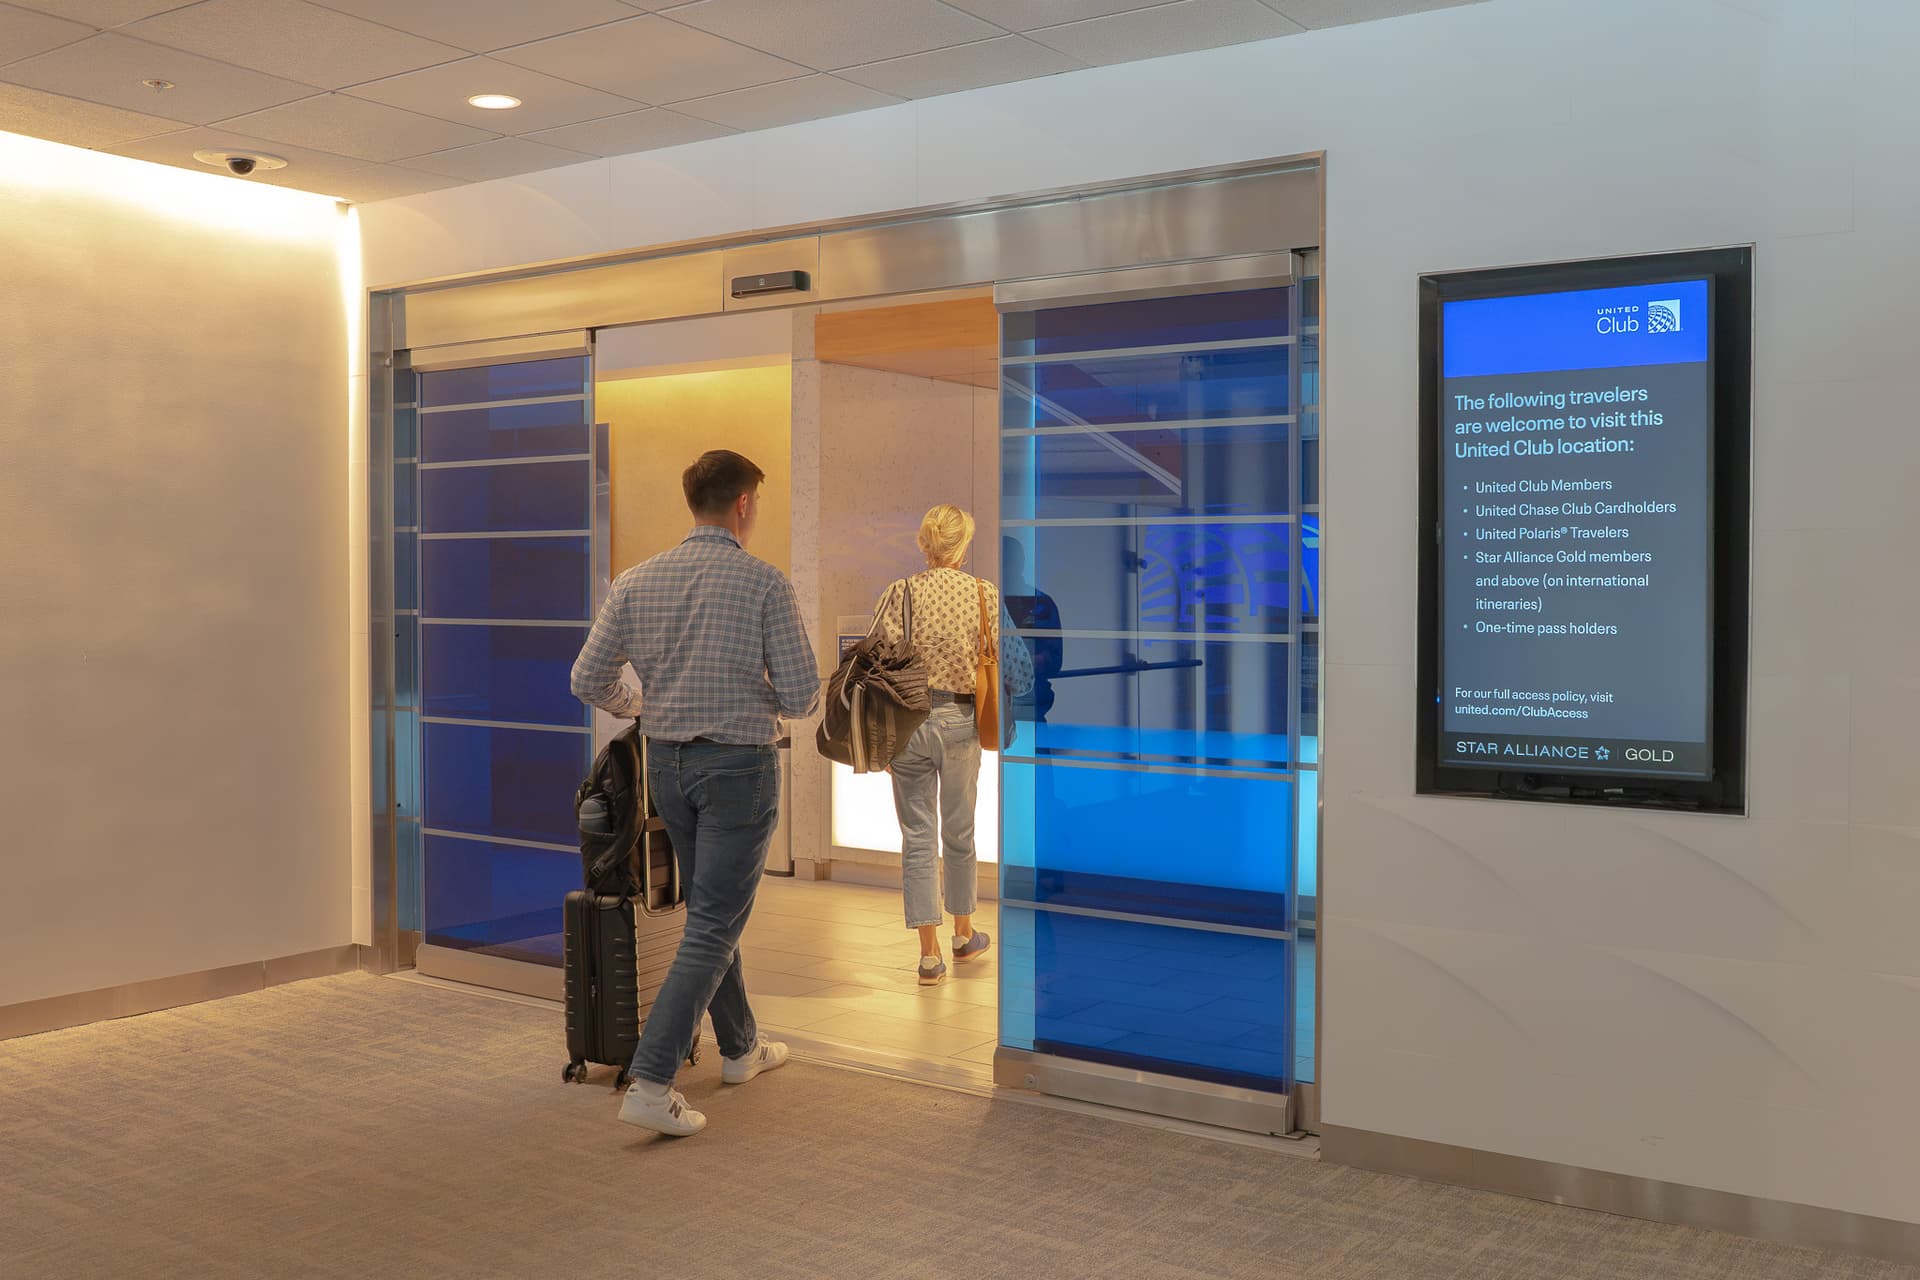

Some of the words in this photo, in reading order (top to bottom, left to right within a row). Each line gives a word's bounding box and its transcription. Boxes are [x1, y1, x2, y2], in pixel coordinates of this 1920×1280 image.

[1597, 306, 1639, 315] UNITED
[1597, 316, 1639, 334] Club
[1455, 395, 1485, 411] The
[1488, 392, 1565, 410] following
[1569, 387, 1648, 405] travelers
[1455, 421, 1482, 434] are
[1486, 416, 1564, 432] welcome
[1569, 416, 1586, 430] to
[1590, 412, 1626, 428] visit
[1630, 411, 1664, 426] this
[1455, 441, 1510, 458] United
[1514, 440, 1554, 456] Club
[1557, 437, 1635, 454] location:
[1475, 481, 1516, 494] United
[1519, 480, 1548, 492] Club
[1551, 479, 1613, 491] Members
[1475, 504, 1516, 517] United
[1519, 503, 1559, 516] Chase
[1562, 503, 1592, 515] Club
[1595, 501, 1677, 514] Cardholders
[1475, 528, 1516, 540] United
[1570, 527, 1629, 539] Travelers
[1475, 551, 1502, 564] Star
[1504, 551, 1554, 563] Alliance
[1556, 551, 1586, 563] Gold
[1589, 551, 1652, 563] members
[1475, 575, 1499, 587] and
[1502, 575, 1539, 587] above
[1543, 573, 1563, 589] (on
[1566, 574, 1649, 587] international
[1475, 597, 1543, 613] itineraries)
[1475, 621, 1535, 634] One-time
[1537, 622, 1566, 637] pass
[1569, 622, 1617, 635] holders
[1455, 687, 1472, 699] For
[1473, 690, 1492, 699] our
[1494, 688, 1510, 700] full
[1512, 690, 1550, 701] access
[1552, 690, 1588, 704] policy,
[1590, 692, 1613, 703] visit
[1455, 704, 1588, 719] united.com/ClubAccess
[1456, 741, 1498, 755] STAR
[1504, 743, 1589, 759] ALLIANCE
[1625, 749, 1674, 762] GOLD
[669, 1100, 682, 1119] N
